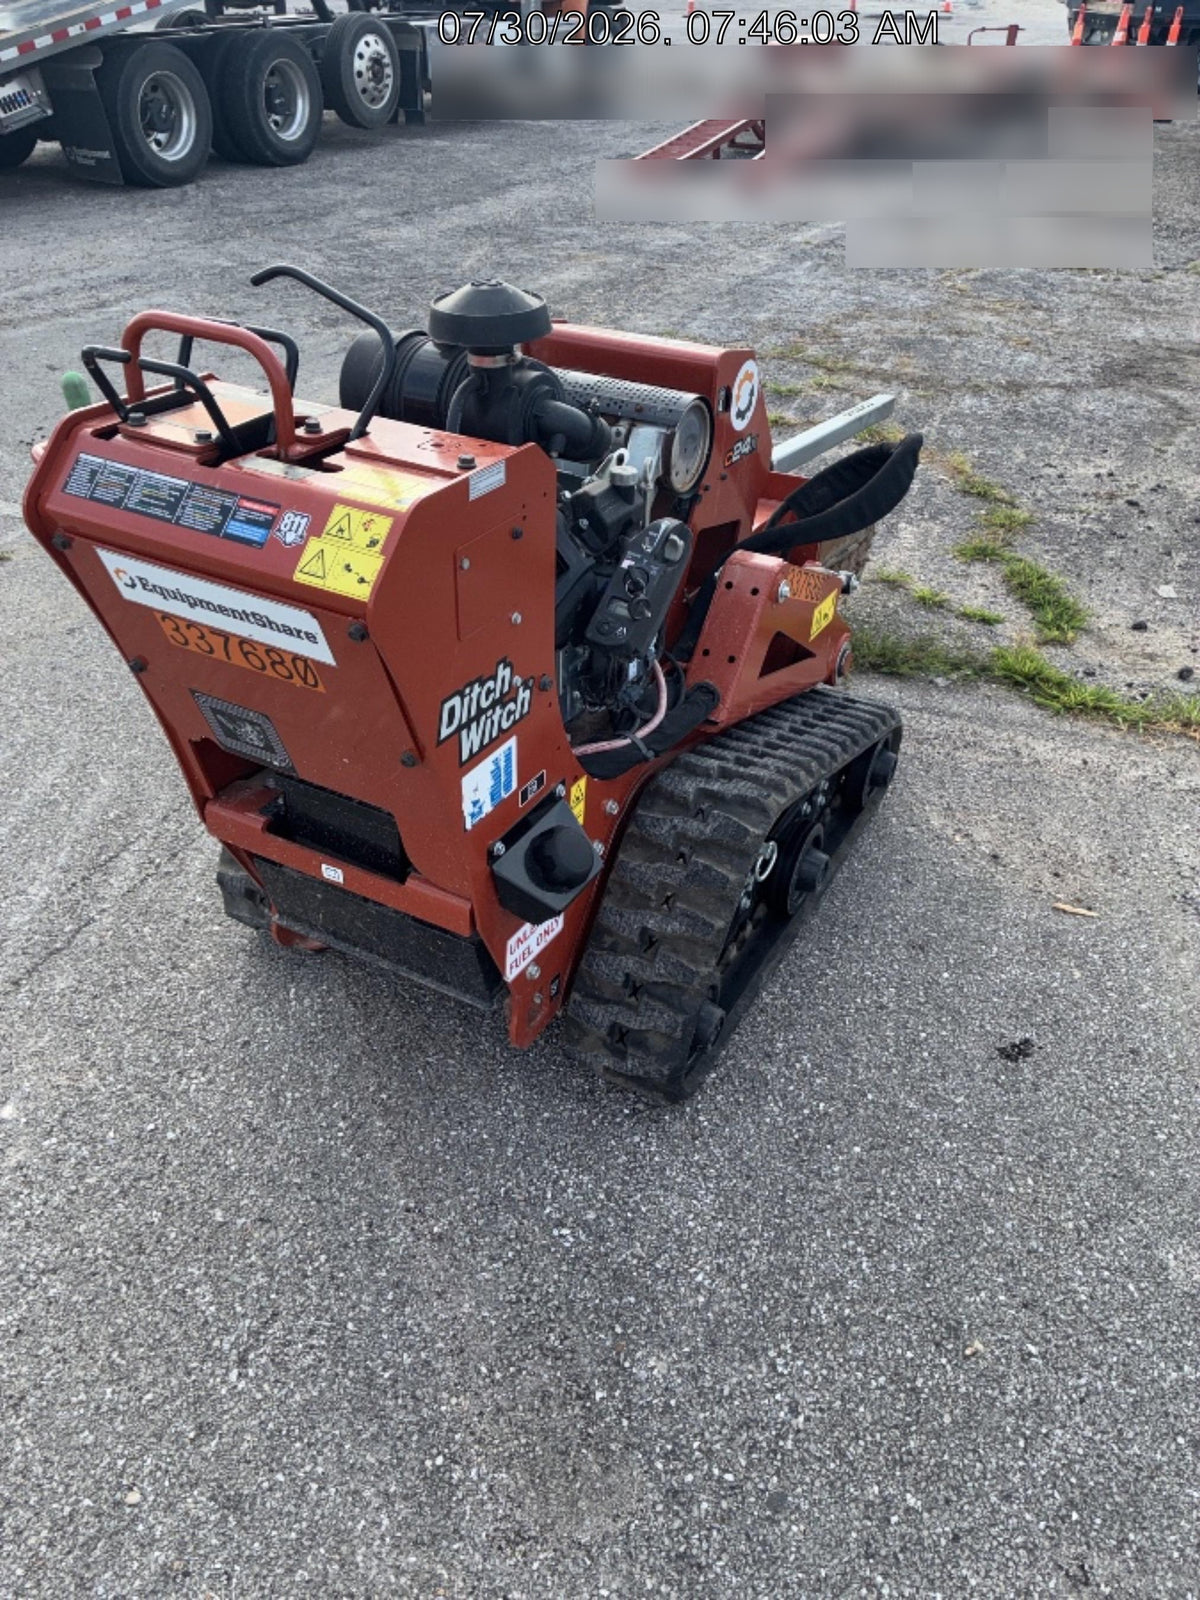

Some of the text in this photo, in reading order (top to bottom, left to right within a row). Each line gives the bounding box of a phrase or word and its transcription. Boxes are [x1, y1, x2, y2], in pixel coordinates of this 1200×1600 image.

[280, 511, 309, 536] 811
[136, 575, 319, 645] EquipmentShare
[160, 613, 319, 689] 337680
[438, 660, 512, 743] Ditch
[460, 683, 532, 764] Witch
[509, 944, 534, 975] FUEL
[535, 917, 560, 947] ONLY
